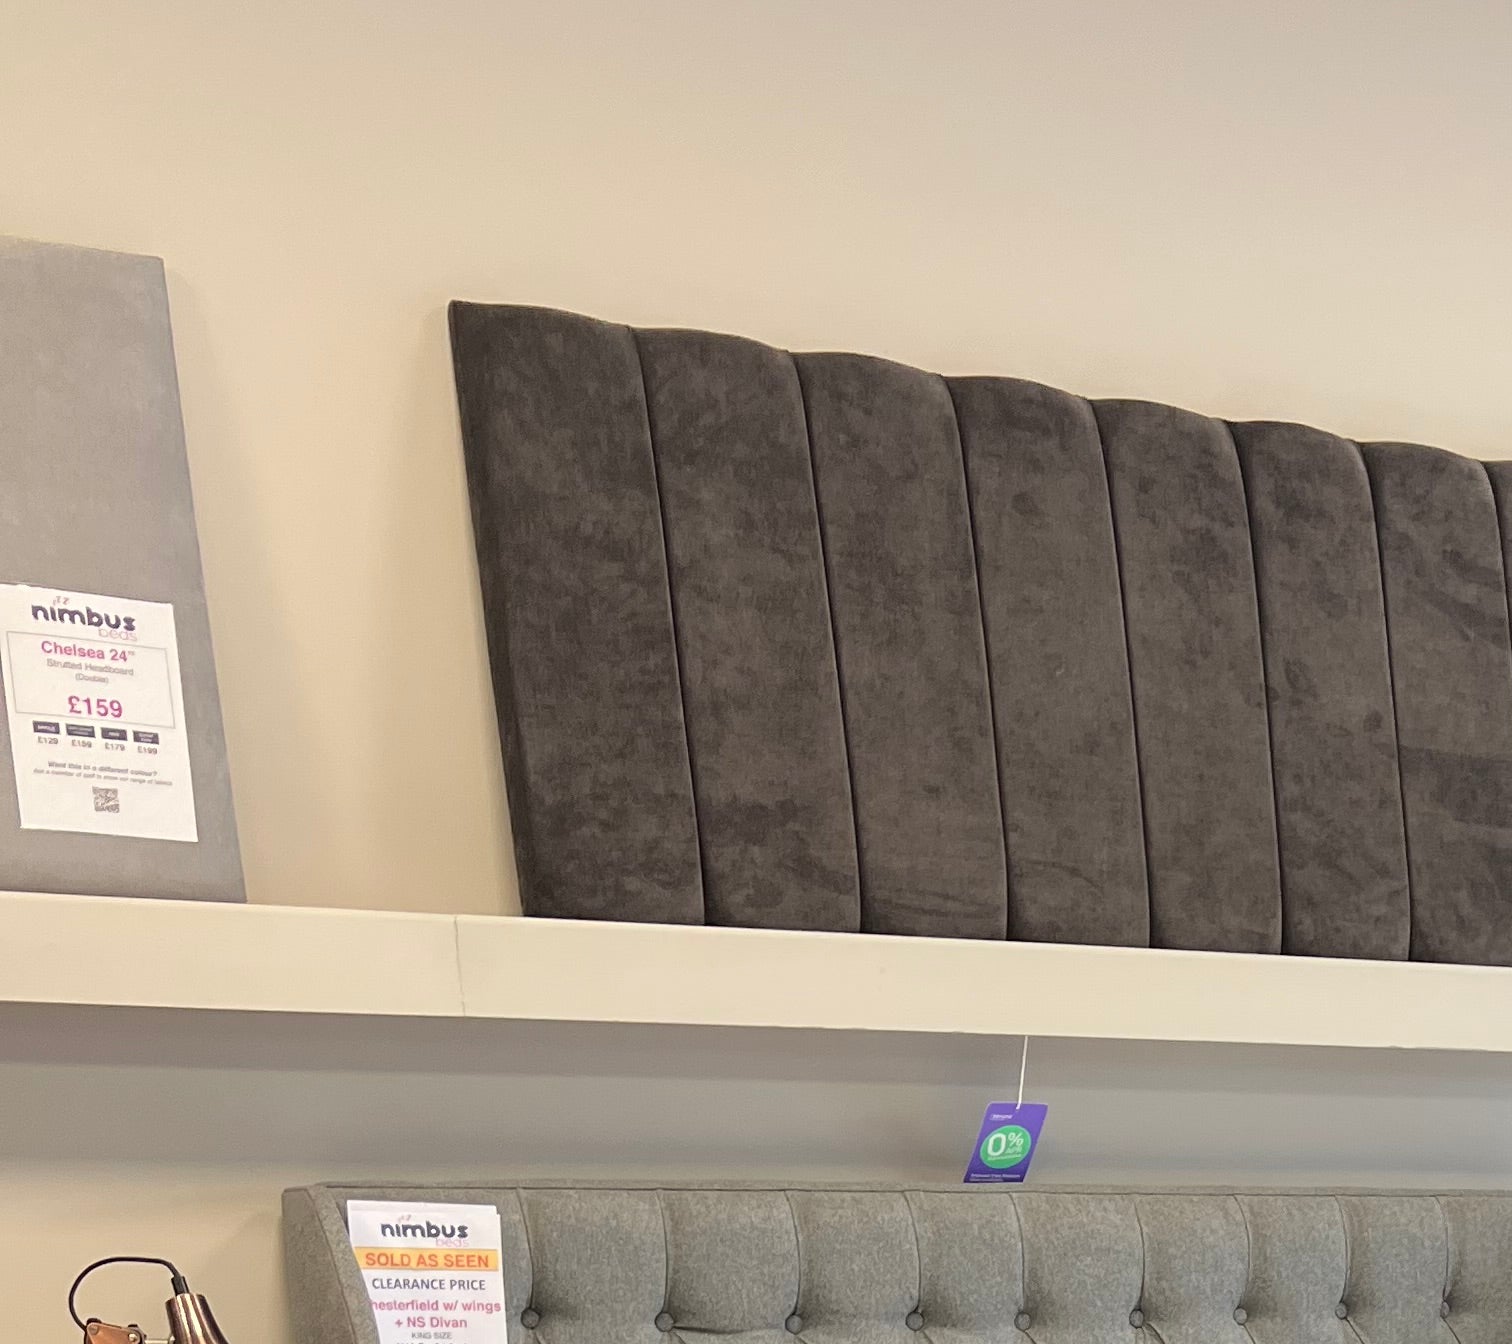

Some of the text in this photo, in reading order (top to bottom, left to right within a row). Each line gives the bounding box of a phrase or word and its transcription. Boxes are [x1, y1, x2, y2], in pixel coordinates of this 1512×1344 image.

[31, 604, 136, 631] nimbus
[41, 640, 105, 660] Chelsea
[68, 695, 123, 718] £159
[380, 1221, 469, 1239] nimbus
[365, 1252, 489, 1268] SOLD AS SEEN
[372, 1278, 486, 1291] CLEARANCE PRICE
[462, 1300, 501, 1314] wings
[407, 1316, 426, 1328] NS
[430, 1316, 468, 1328] Divan
